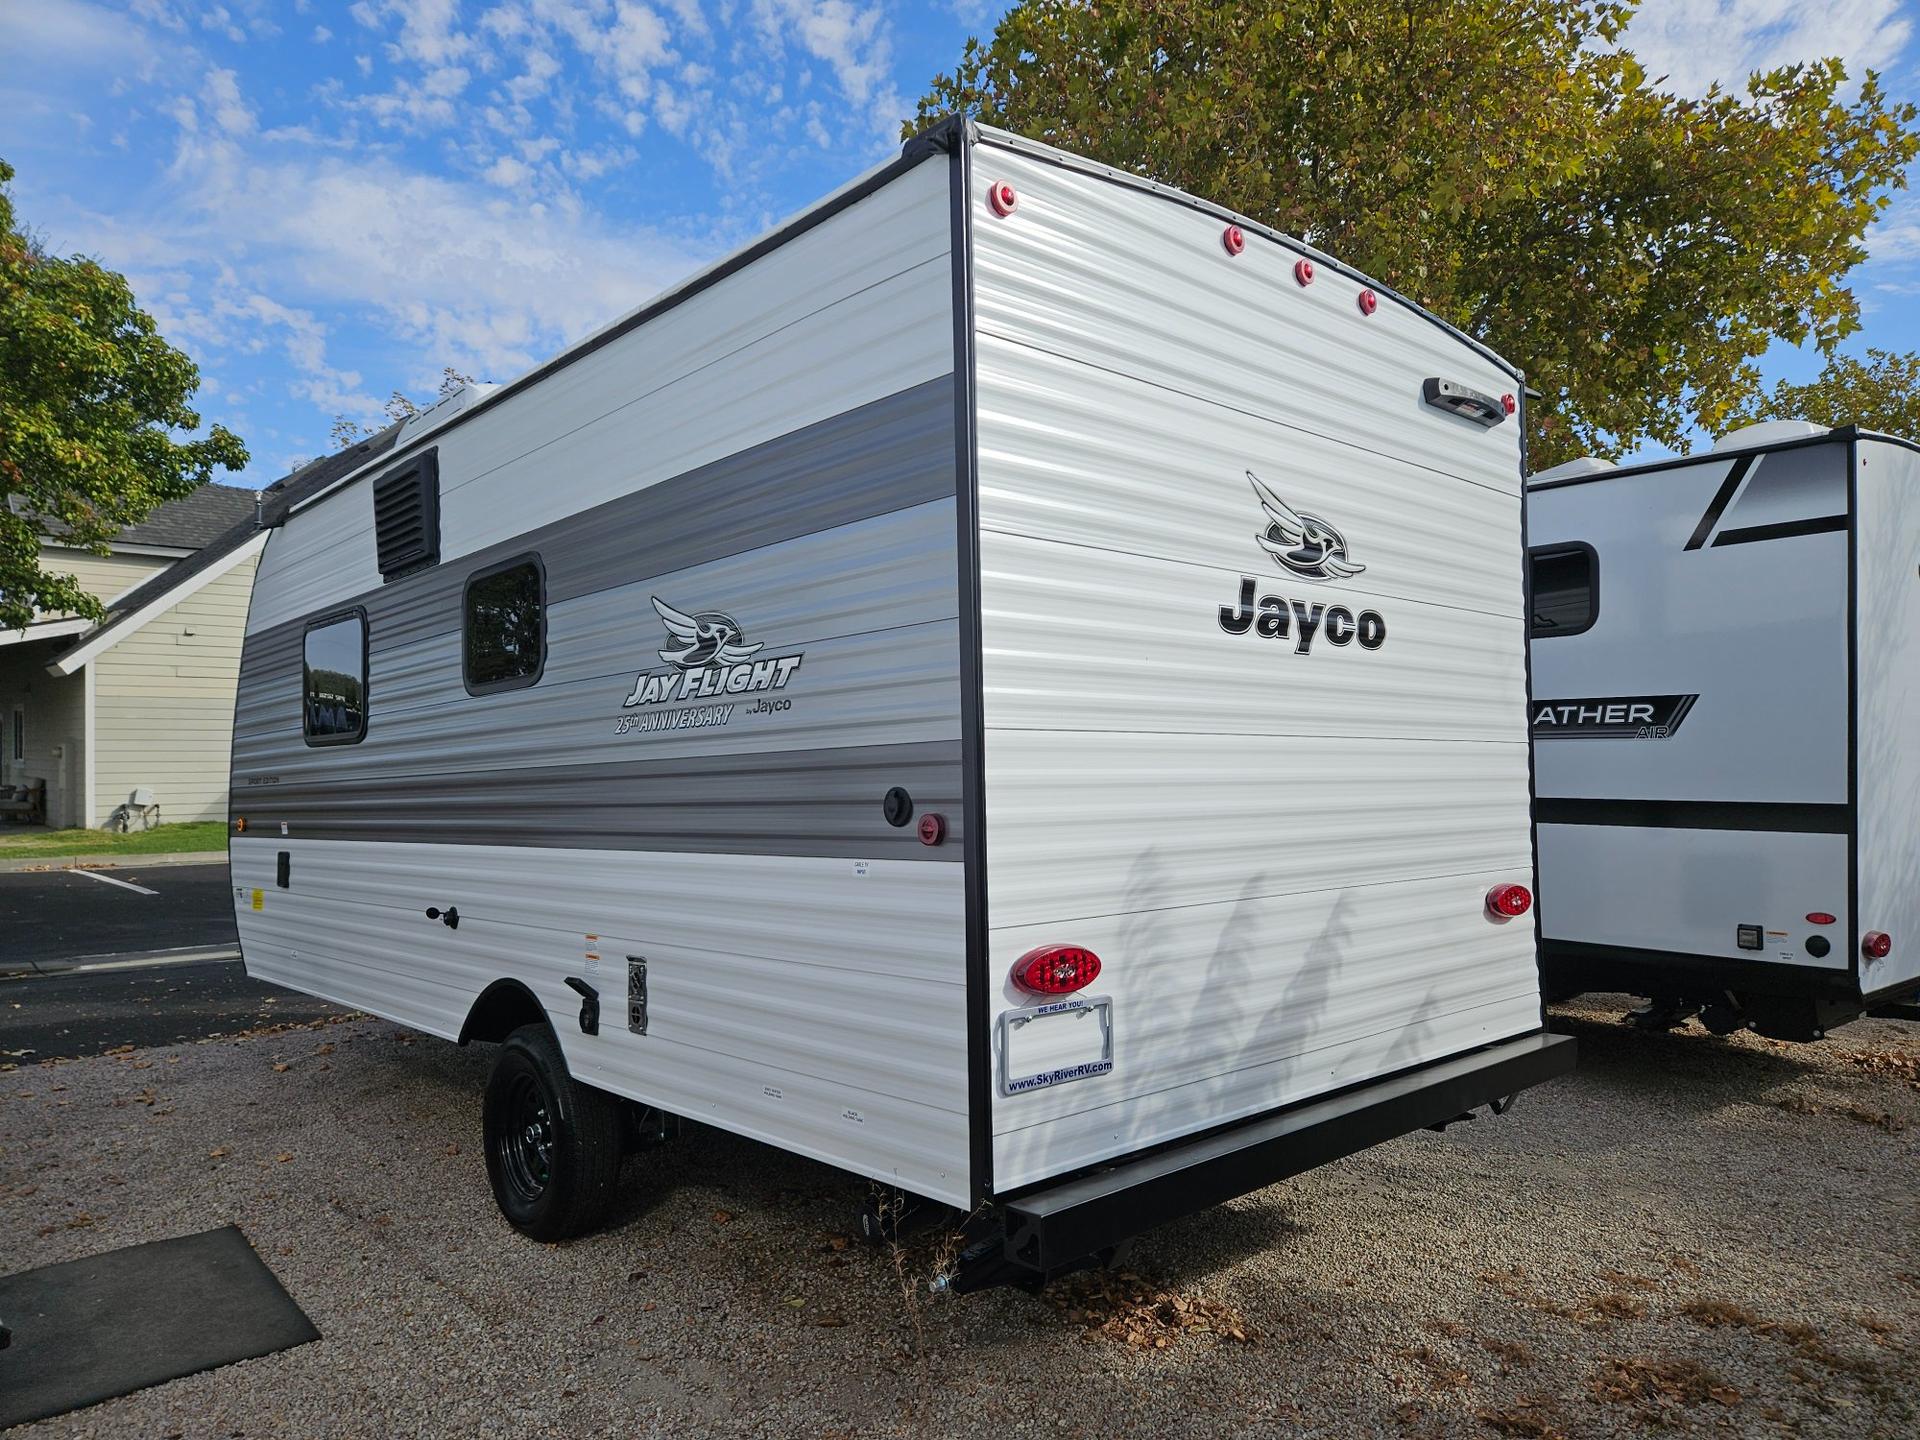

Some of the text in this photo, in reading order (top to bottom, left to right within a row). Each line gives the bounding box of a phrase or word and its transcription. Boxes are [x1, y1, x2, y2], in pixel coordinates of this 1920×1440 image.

[1218, 575, 1387, 655] Jayco
[623, 653, 804, 708] JAY FLIGHT
[614, 703, 734, 735] 25th ANNIVERSARY
[752, 698, 791, 716] Jayco
[1635, 726, 1670, 739] AIR
[1038, 1006, 1048, 1014] WE
[1049, 1003, 1067, 1013] HEAR
[1009, 1061, 1112, 1091] www.SkyRiverRV.com
